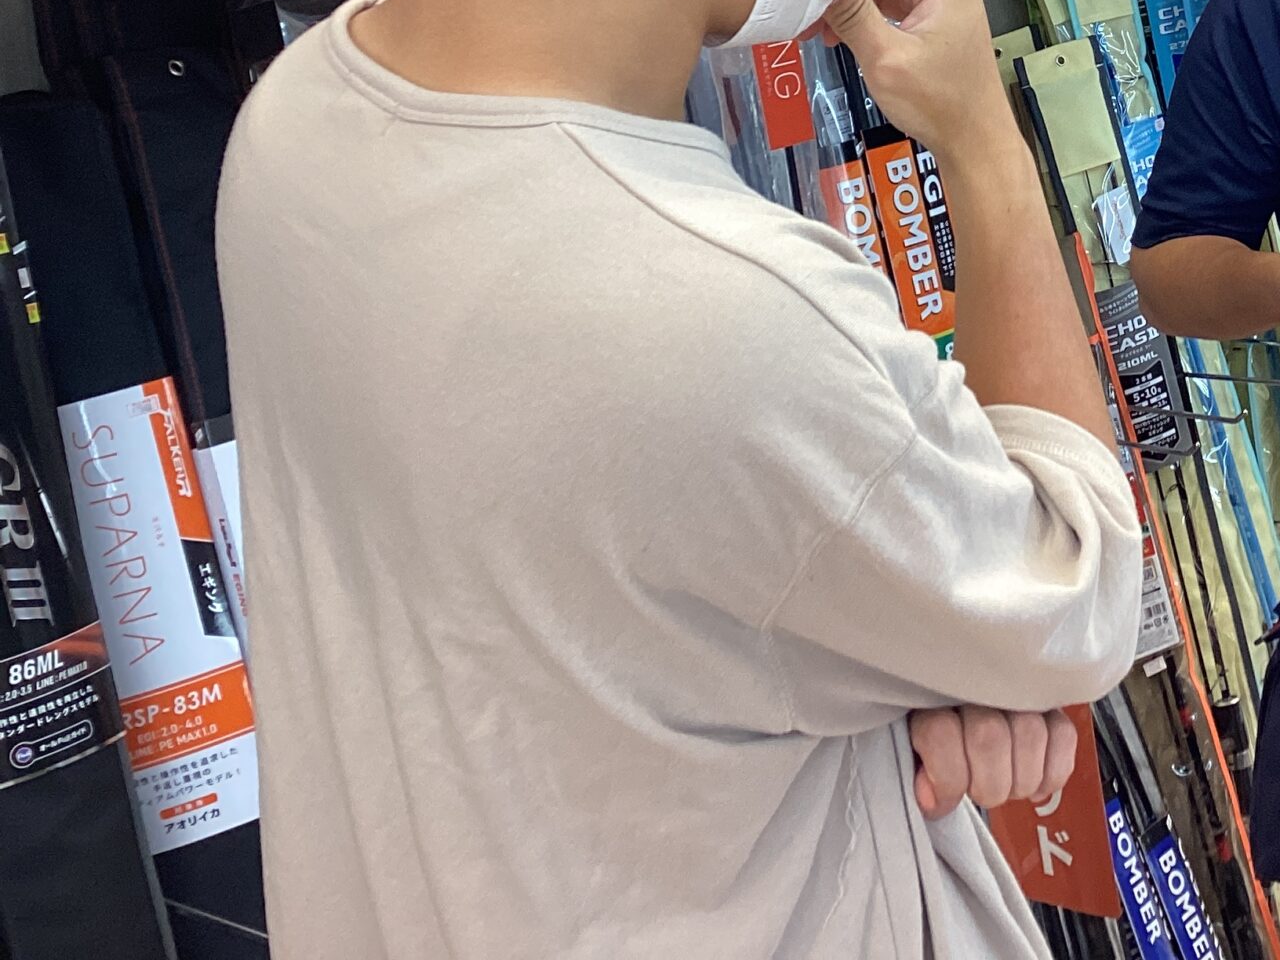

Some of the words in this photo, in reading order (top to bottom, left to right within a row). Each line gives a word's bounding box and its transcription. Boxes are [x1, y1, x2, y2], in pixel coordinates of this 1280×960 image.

[767, 40, 801, 100] NG
[916, 150, 947, 218] EGI
[836, 176, 883, 272] BOM
[886, 157, 943, 320] BOMBER
[1117, 352, 1159, 372] 210ML
[71, 424, 165, 666] SUPARNA
[198, 562, 224, 614] エギング
[9, 649, 65, 686] 86ML
[122, 683, 222, 731] RSP-83M
[164, 807, 221, 834] アオリイカ
[1108, 810, 1162, 945] BOMBER
